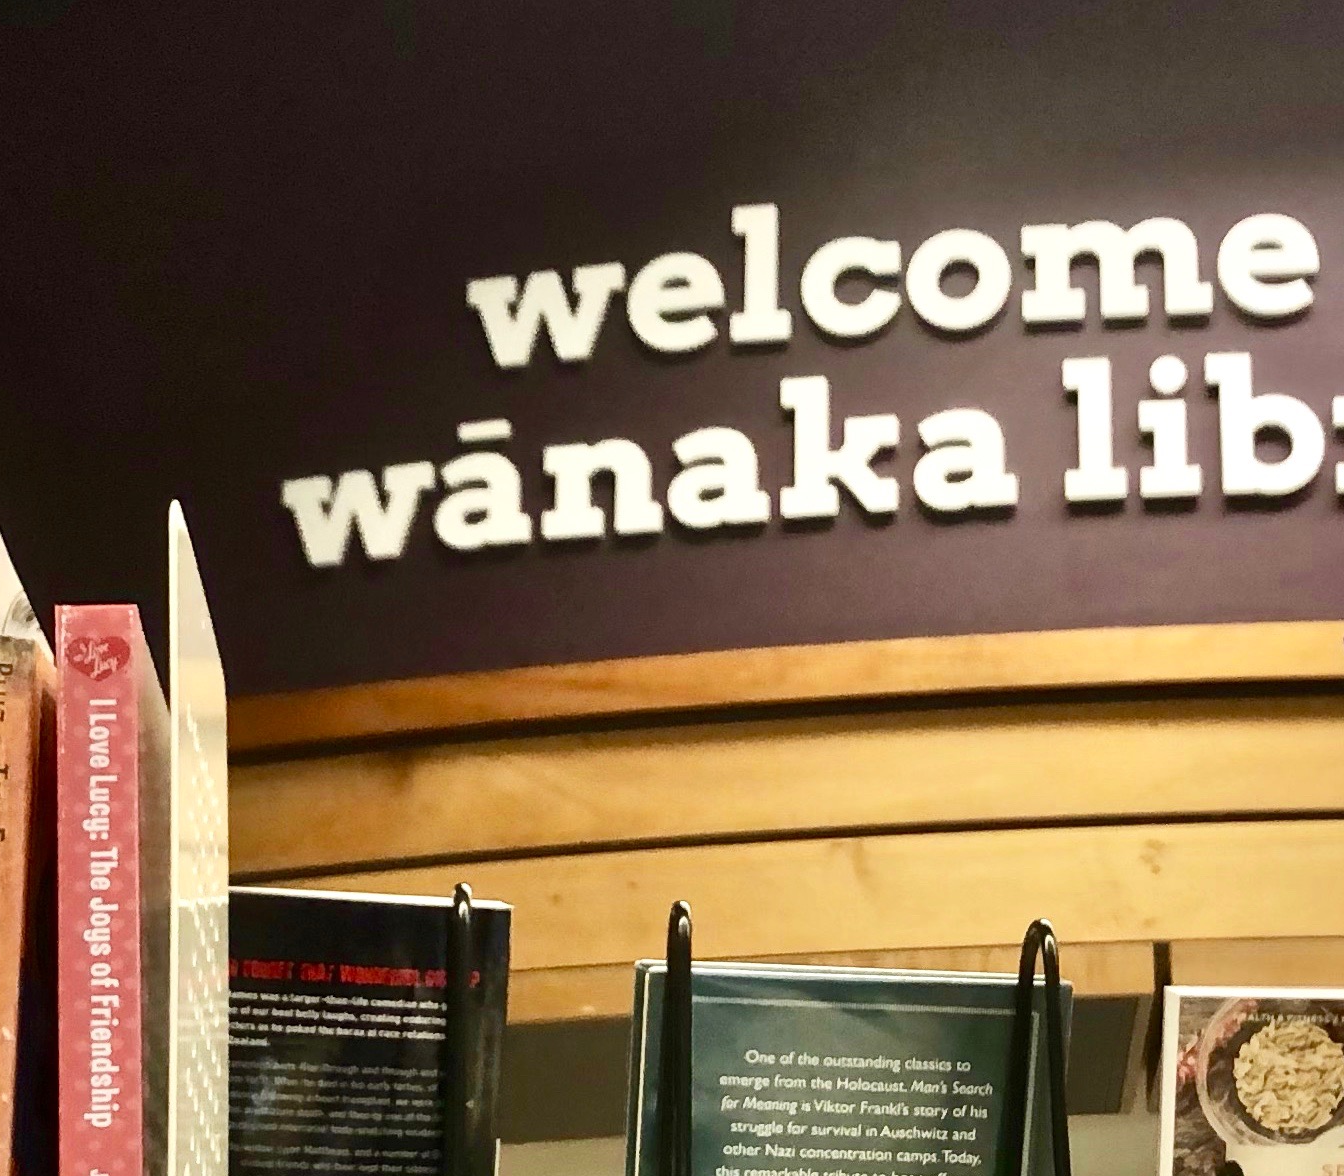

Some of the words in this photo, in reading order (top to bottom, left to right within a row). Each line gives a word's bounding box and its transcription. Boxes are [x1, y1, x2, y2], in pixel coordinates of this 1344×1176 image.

[466, 202, 1321, 369] welcome
[281, 375, 1021, 569] wānaka
[89, 712, 117, 768] Love
[83, 774, 118, 841] Lucy:
[90, 849, 118, 892] The
[83, 898, 119, 956] Joys
[90, 962, 118, 985] of
[84, 990, 120, 1128] Friendship
[719, 1075, 770, 1091] emerge
[774, 1074, 807, 1089] from
[811, 1076, 832, 1090] the
[953, 1081, 993, 1096] Search
[744, 1049, 775, 1065] One
[780, 1052, 794, 1066] of
[797, 1052, 819, 1067] the
[823, 1054, 900, 1073] outstanding
[905, 1057, 952, 1071] classics
[957, 1060, 971, 1071] to
[721, 1096, 740, 1112] for
[744, 1097, 798, 1115] Meaning
[801, 1099, 811, 1113] is
[813, 1099, 855, 1114] Viktor
[860, 1101, 909, 1115] Frankl's
[914, 1106, 948, 1119] story
[953, 1104, 967, 1117] of
[970, 1106, 988, 1119] his
